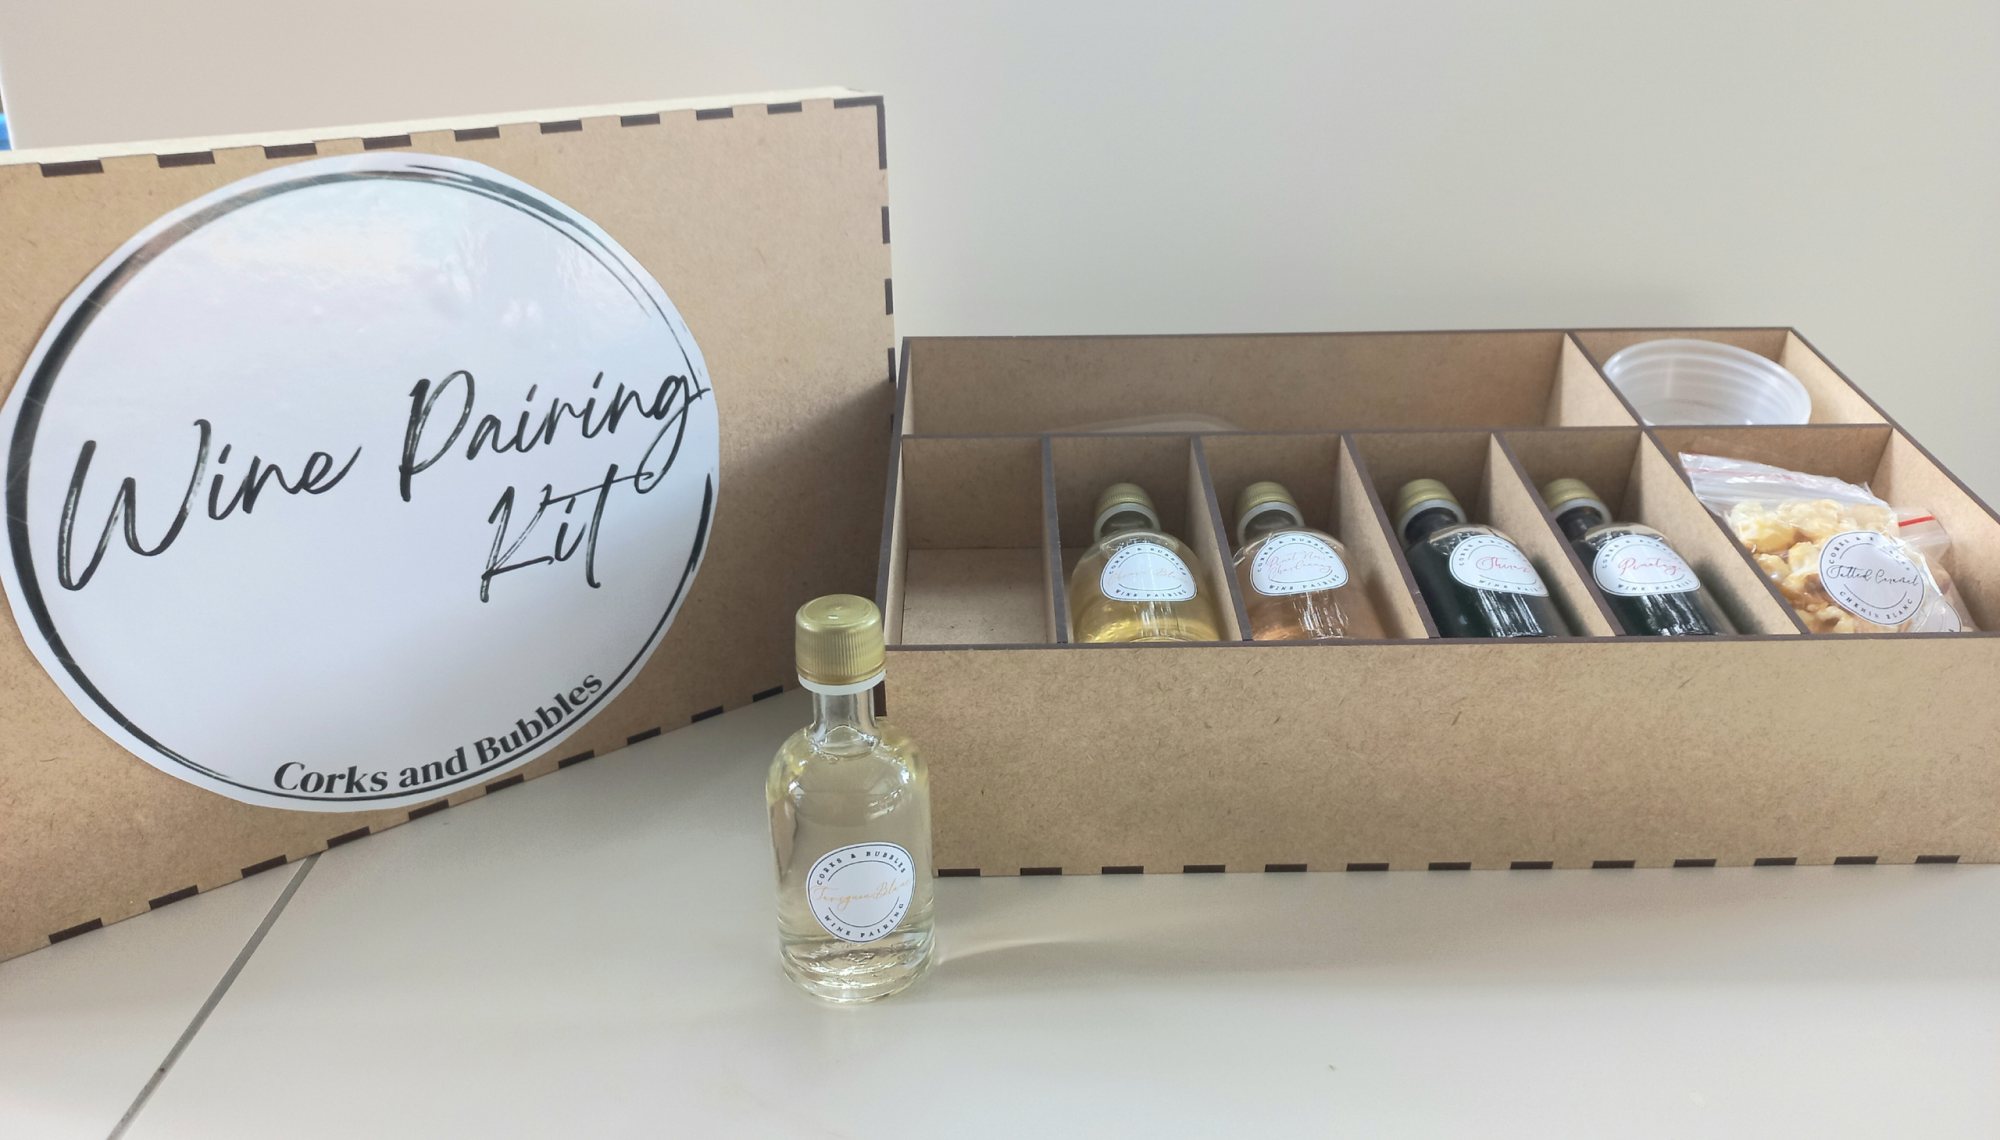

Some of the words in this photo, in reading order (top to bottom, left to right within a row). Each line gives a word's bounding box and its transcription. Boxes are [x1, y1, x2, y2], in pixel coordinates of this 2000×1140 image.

[57, 418, 362, 591] Wine
[398, 369, 711, 503] Pairing
[479, 462, 650, 603] Kit
[1829, 539, 1850, 564] CORKS
[273, 760, 388, 795] Corks
[398, 746, 468, 789] and
[473, 673, 604, 766] Bubbles
[816, 857, 843, 886] CORKS
[866, 850, 906, 873] BUBBLES
[824, 915, 852, 937] WINE
[860, 903, 905, 938] PAIRING
